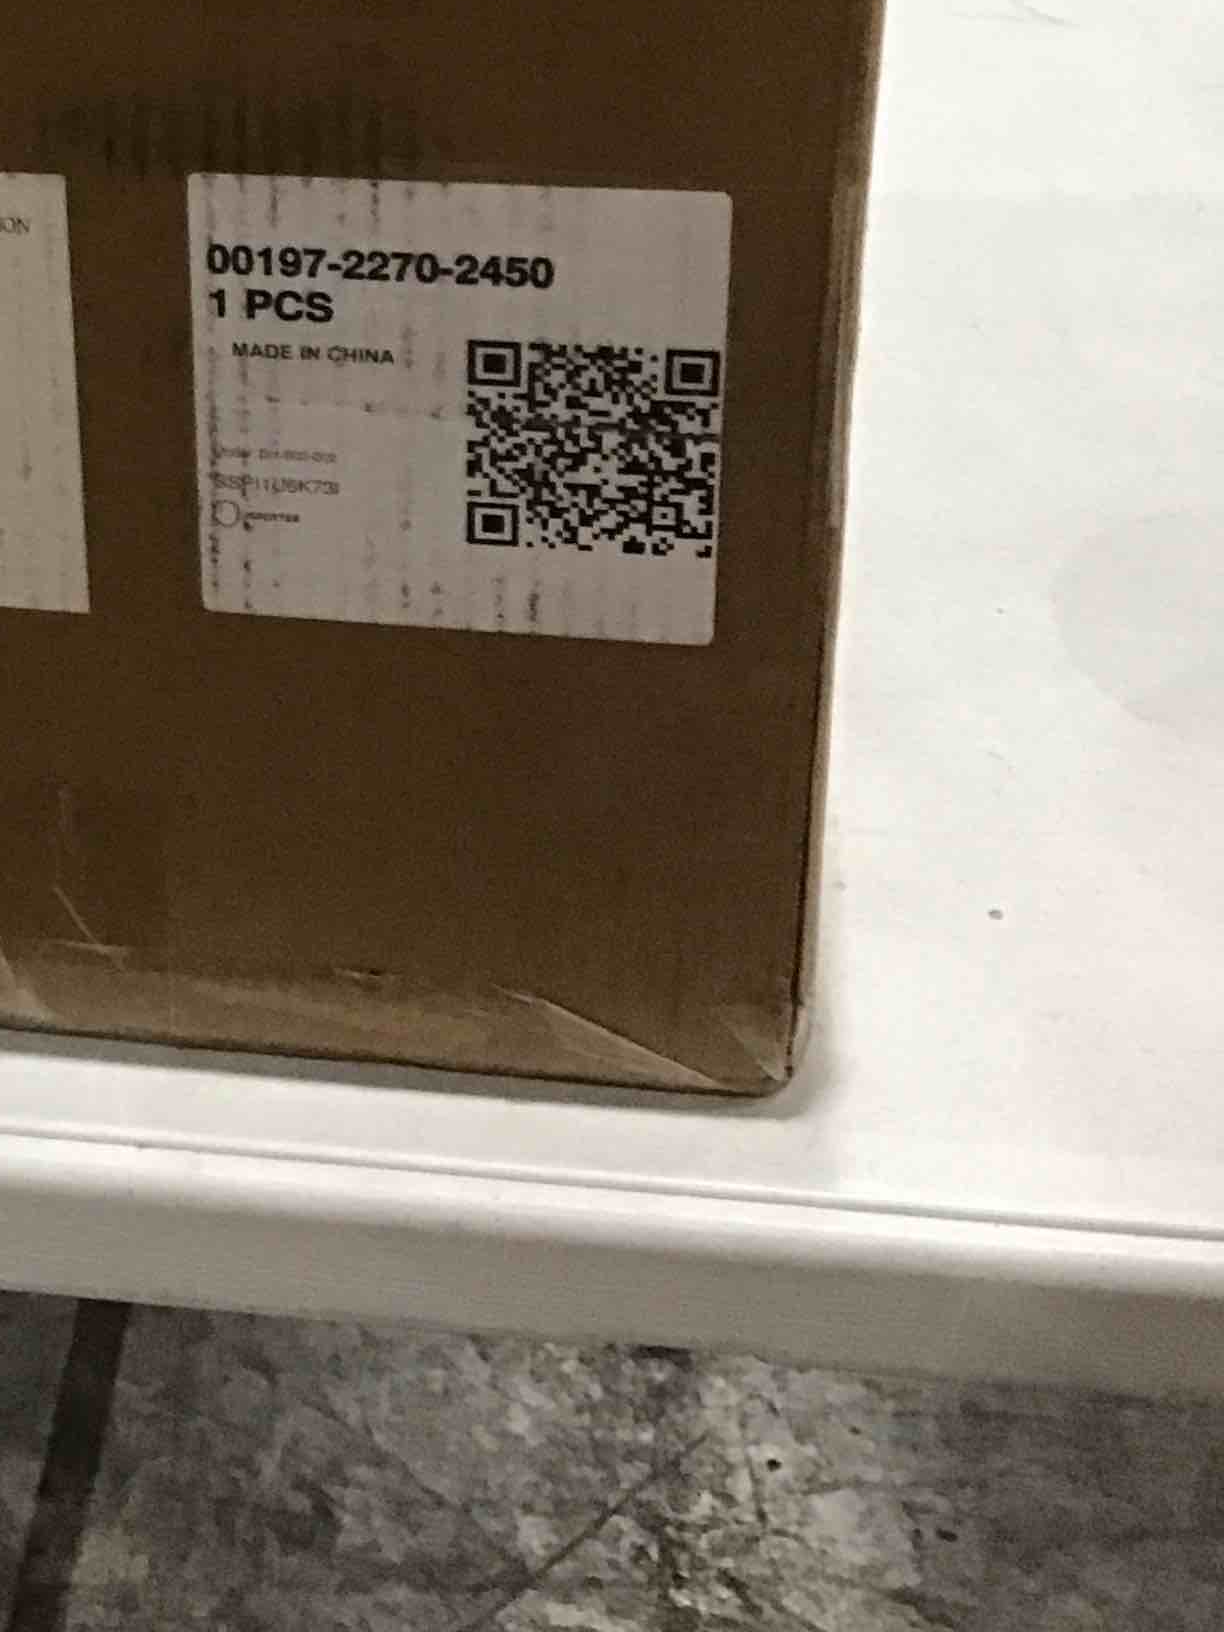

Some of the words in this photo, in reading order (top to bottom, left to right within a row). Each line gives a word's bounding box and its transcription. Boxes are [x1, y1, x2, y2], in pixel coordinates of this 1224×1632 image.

[206, 243, 555, 289] 00197-2270-2450
[208, 288, 227, 318] 1
[245, 289, 334, 323] PCS
[232, 342, 293, 361] MADE
[299, 344, 327, 361] IN
[328, 344, 395, 365] CHINA
